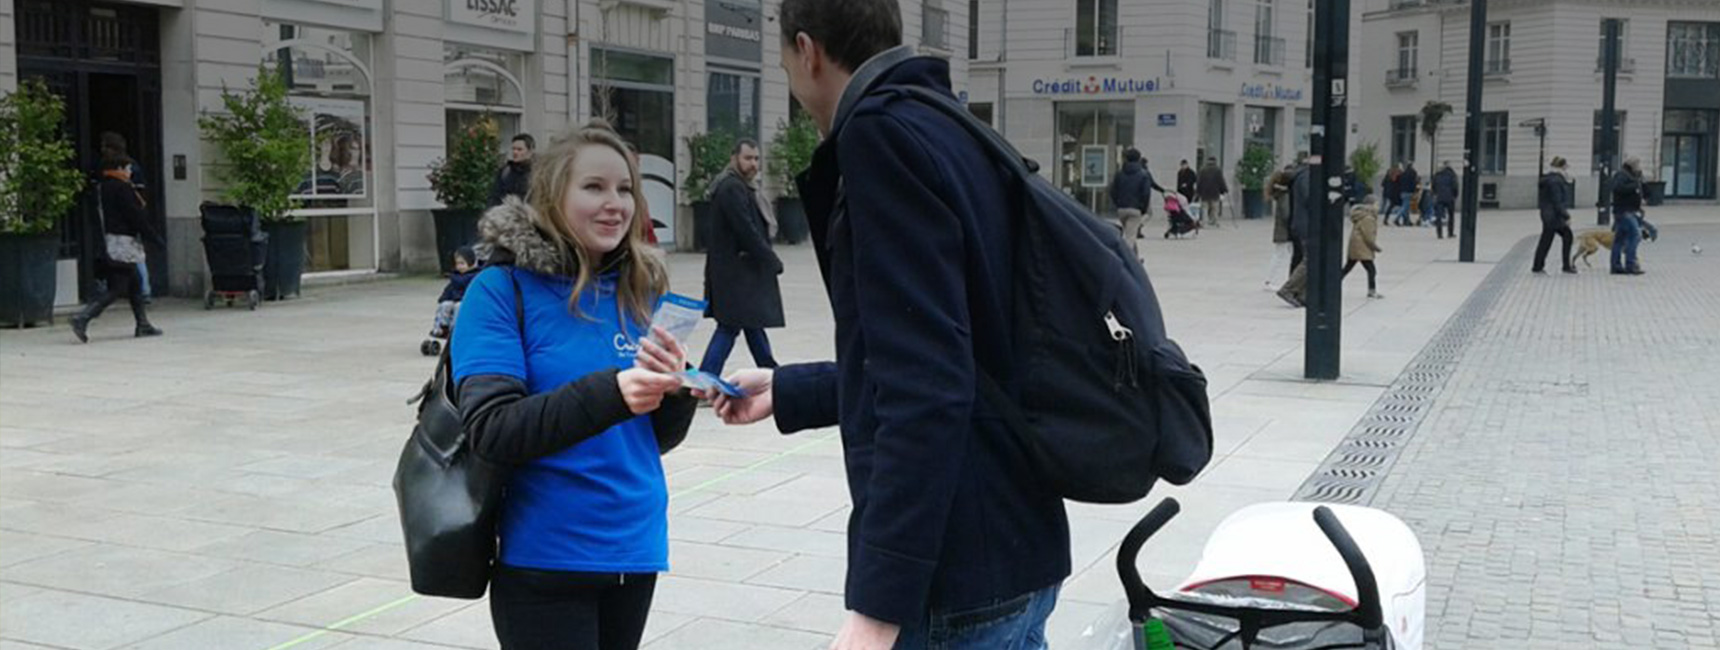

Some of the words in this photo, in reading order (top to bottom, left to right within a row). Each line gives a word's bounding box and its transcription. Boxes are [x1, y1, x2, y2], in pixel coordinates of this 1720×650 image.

[466, 0, 517, 17] LISSAC
[1032, 79, 1081, 94] Crédit
[1102, 77, 1160, 93] Mutuel
